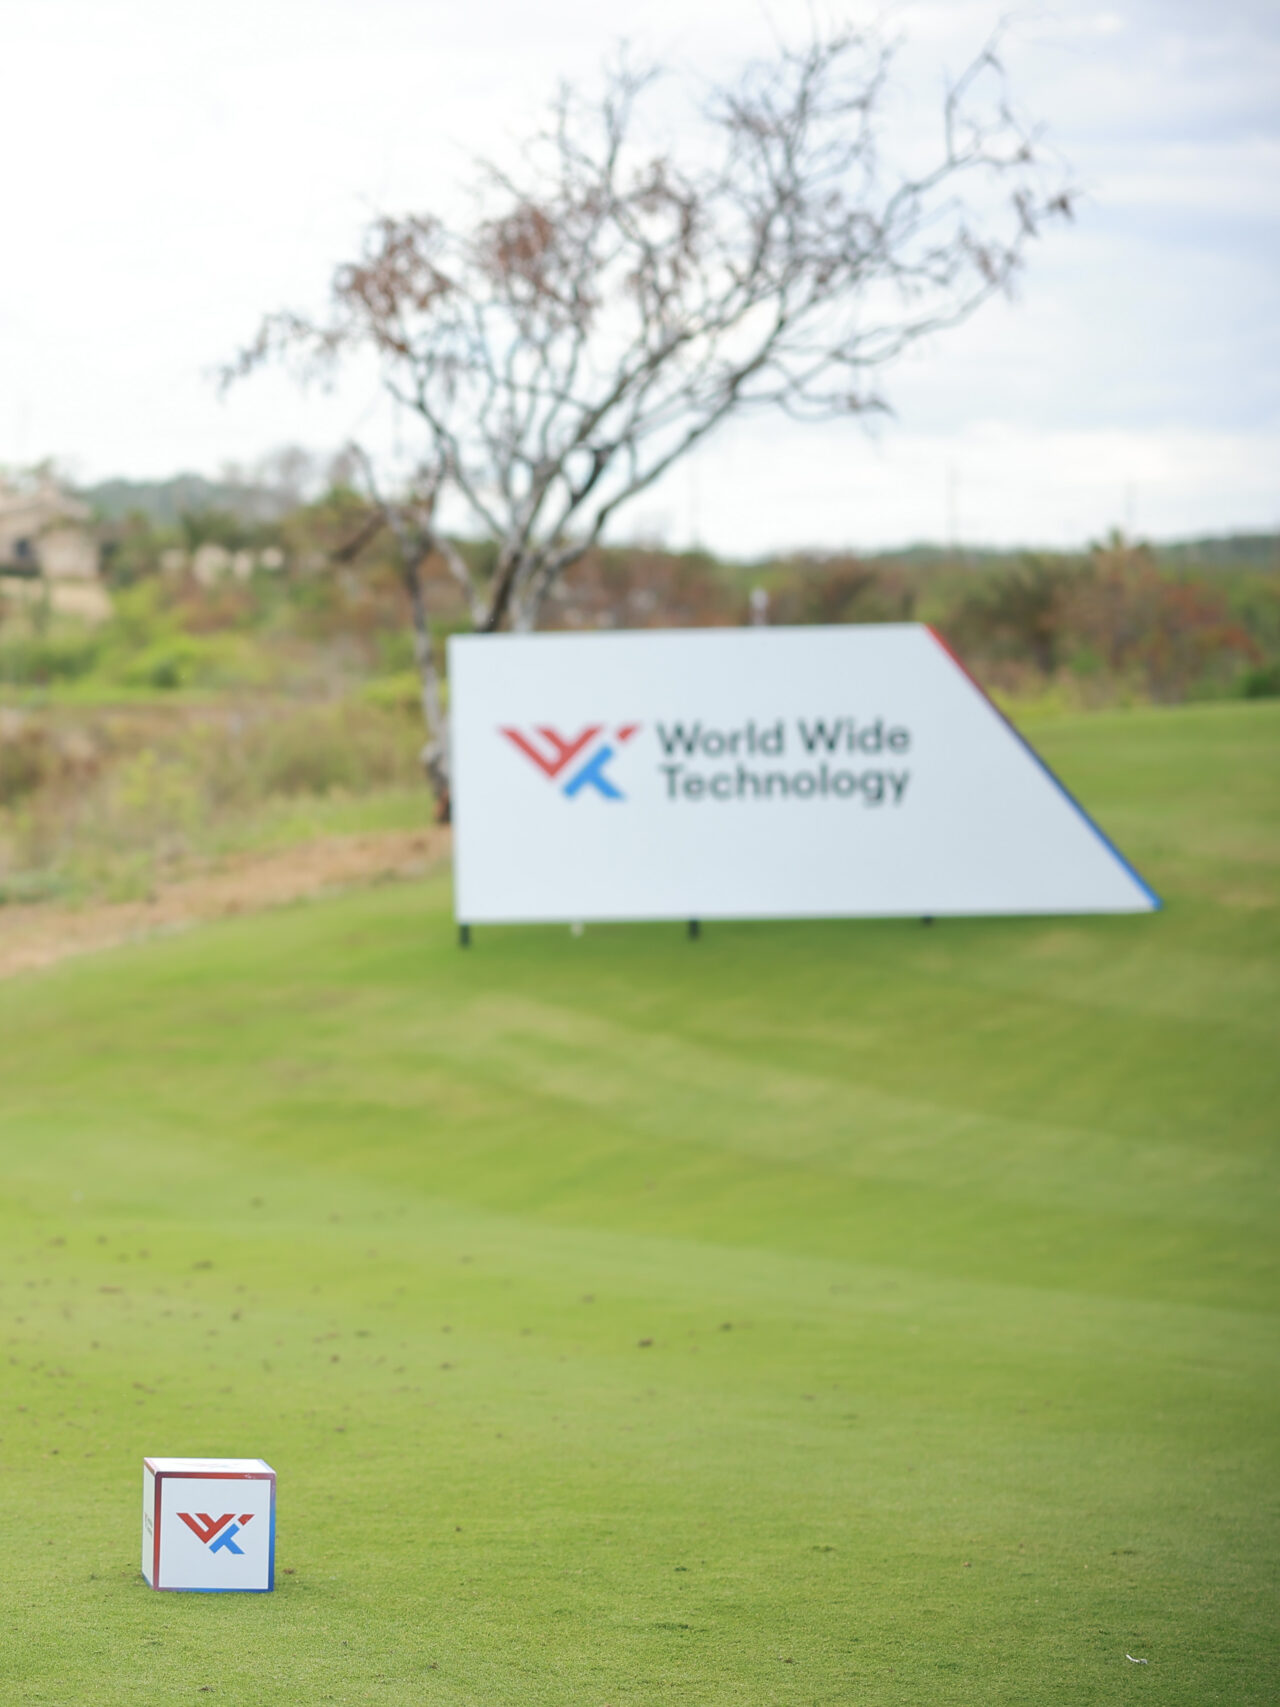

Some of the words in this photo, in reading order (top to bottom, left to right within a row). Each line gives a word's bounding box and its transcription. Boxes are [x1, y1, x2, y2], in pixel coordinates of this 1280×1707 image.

[656, 720, 785, 757] World
[797, 717, 911, 755] Wide
[658, 761, 911, 808] Technology
